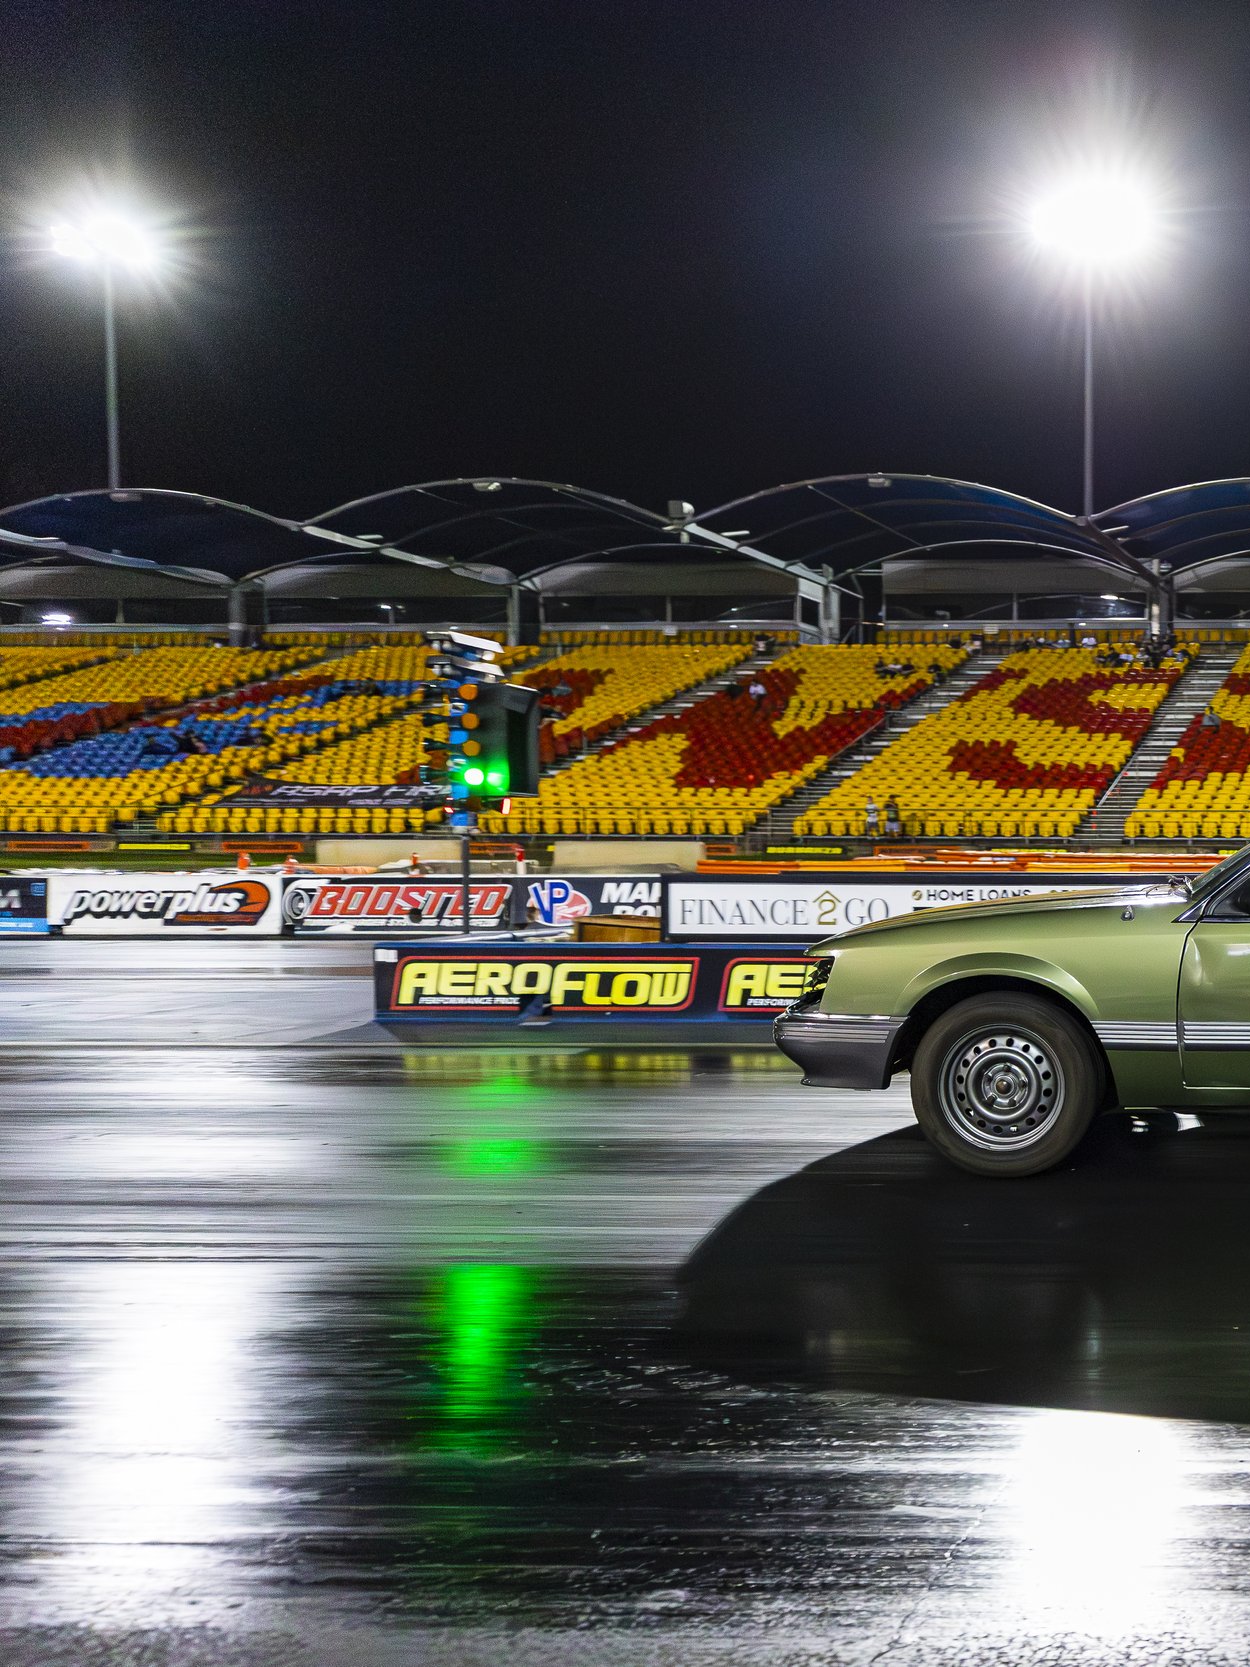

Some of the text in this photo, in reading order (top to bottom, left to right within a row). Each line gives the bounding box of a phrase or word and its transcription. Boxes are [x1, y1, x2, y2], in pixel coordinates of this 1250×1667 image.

[63, 883, 246, 926] powerplus
[310, 885, 508, 917] BOOSTED
[926, 889, 974, 901] HOME
[680, 899, 808, 925] FINANCE
[398, 963, 692, 1006] AEROFLOW
